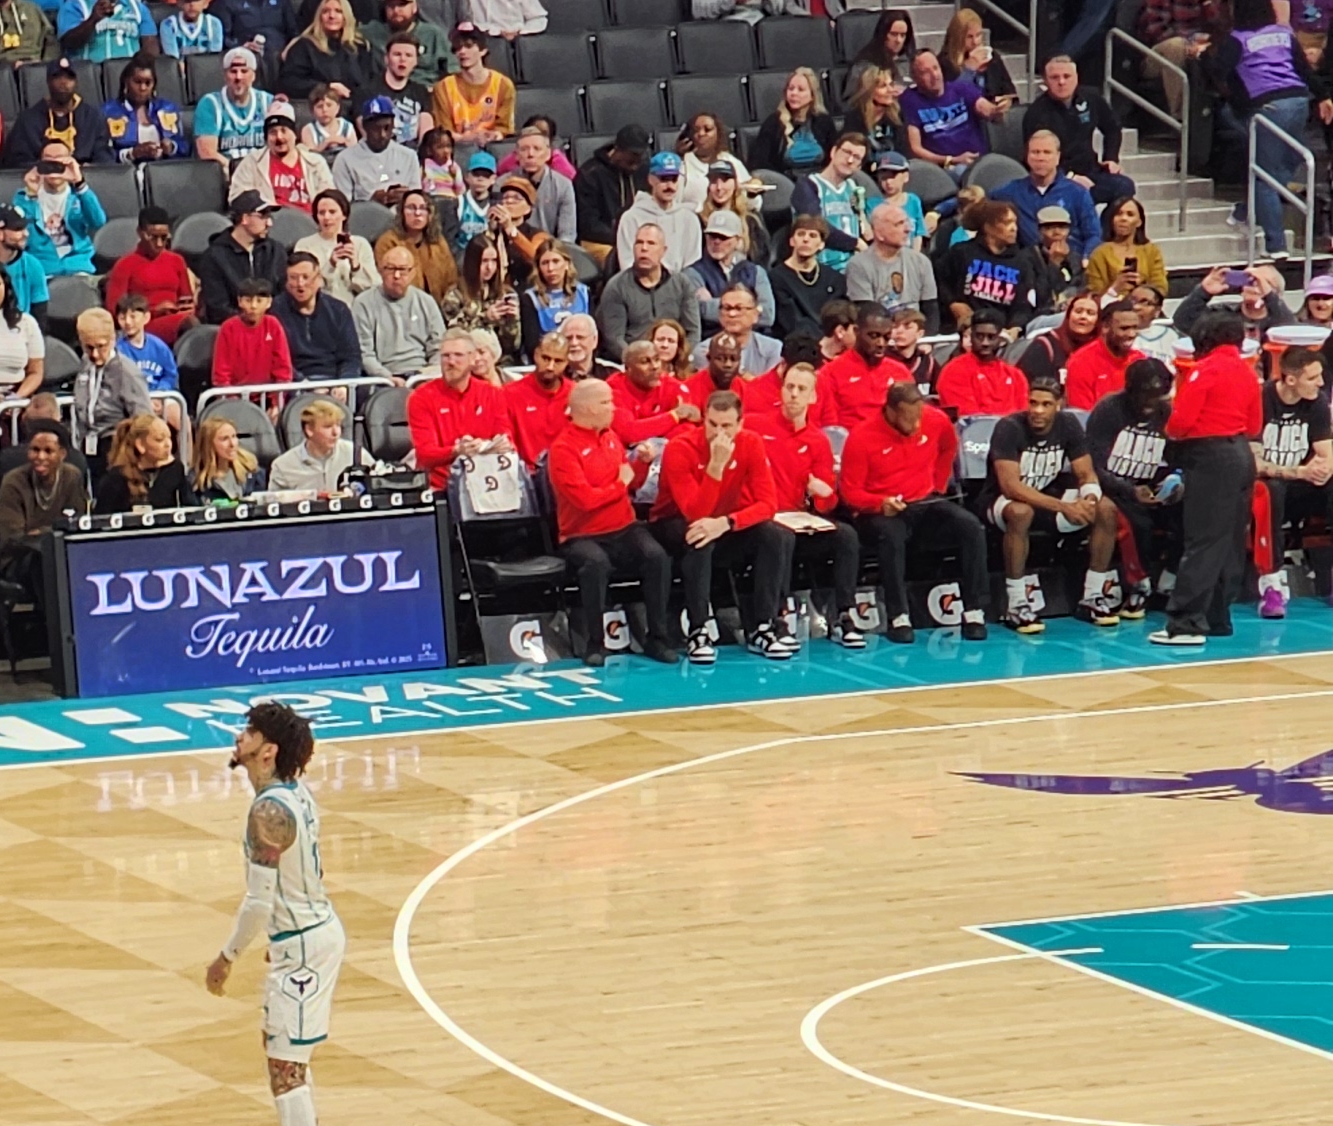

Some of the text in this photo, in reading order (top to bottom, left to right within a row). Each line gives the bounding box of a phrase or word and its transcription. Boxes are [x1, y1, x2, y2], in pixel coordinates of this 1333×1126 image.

[968, 259, 1020, 284] JACK
[971, 276, 1016, 301] JILL
[86, 550, 420, 615] LUNAZUL
[928, 582, 965, 625] G
[185, 605, 334, 667] Tequila
[510, 620, 547, 663] G
[164, 668, 602, 718] NOVANT
